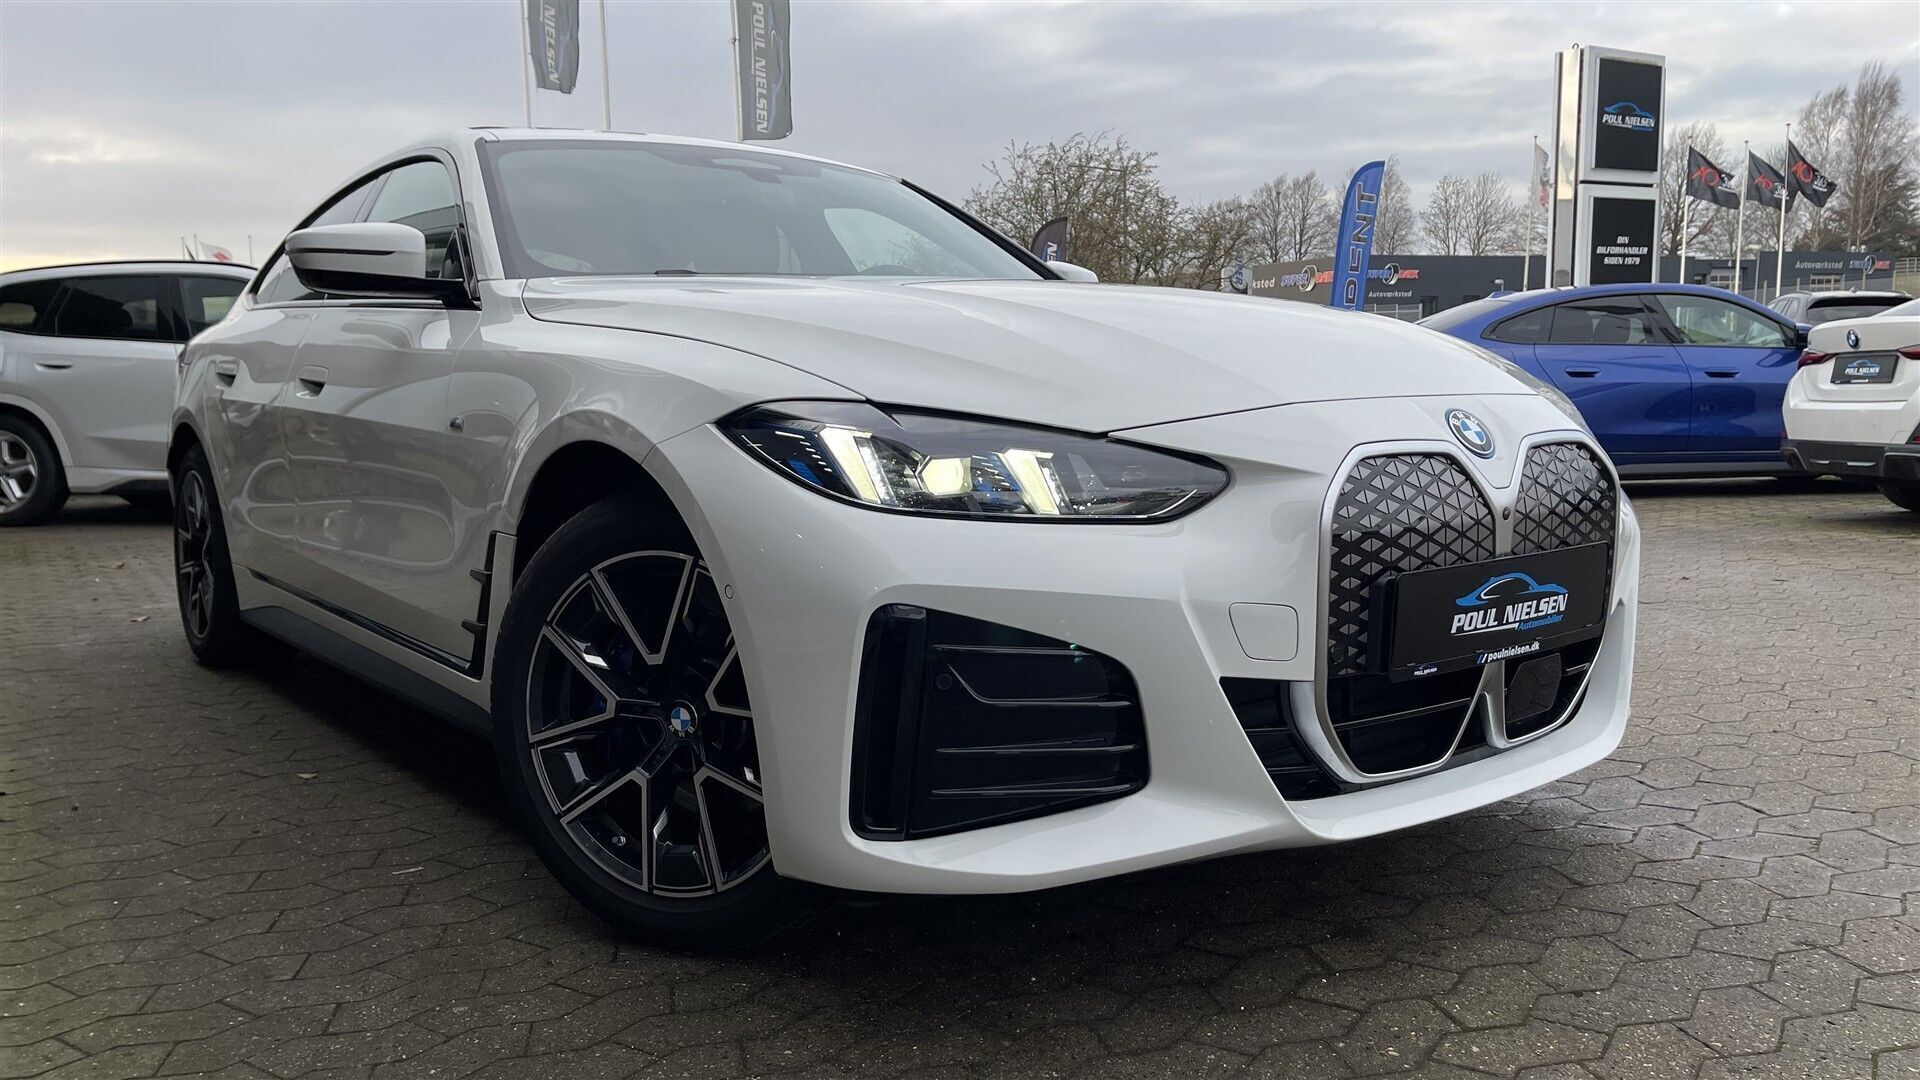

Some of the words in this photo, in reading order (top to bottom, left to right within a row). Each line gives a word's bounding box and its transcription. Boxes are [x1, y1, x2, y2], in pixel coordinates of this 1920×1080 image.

[752, 0, 766, 50] POUL
[544, 4, 559, 83] NIELSEN
[755, 56, 768, 133] NIELSEN
[1602, 113, 1623, 124] POUL
[1624, 115, 1656, 127] NIELSEN
[1344, 181, 1377, 311] DENT
[1617, 235, 1629, 244] DIN
[1596, 245, 1649, 255] BILFORHANDLER
[1604, 256, 1623, 265] SIDEN
[1624, 257, 1640, 265] 1979
[1795, 260, 1844, 269] Autoværksted
[1252, 276, 1276, 289] ksted
[1280, 273, 1309, 287] SUPER
[1368, 290, 1413, 298] Autoværksted
[1451, 608, 1499, 634] POUL
[1502, 593, 1568, 624] NIELSEN
[1518, 614, 1564, 631] Automobiler
